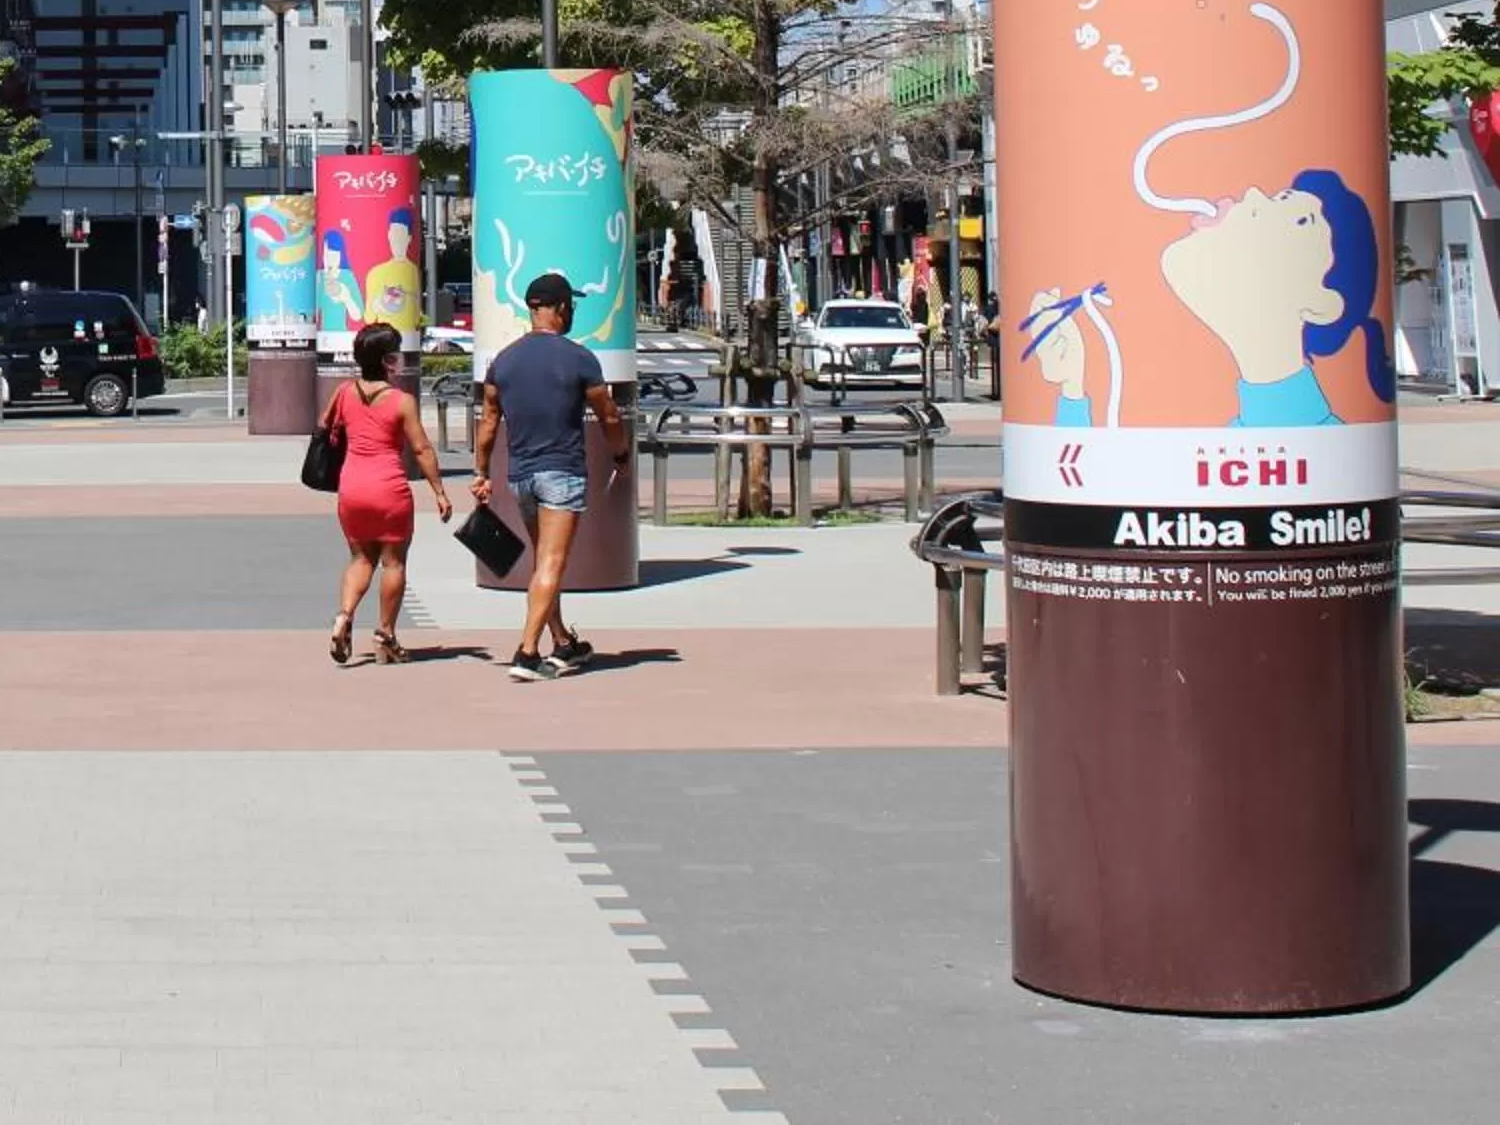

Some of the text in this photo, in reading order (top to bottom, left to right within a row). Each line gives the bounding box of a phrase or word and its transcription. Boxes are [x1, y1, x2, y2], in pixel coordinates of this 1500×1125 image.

[1196, 458, 1309, 487] ICHI
[1113, 506, 1372, 547] Akiba Smile!
[1215, 567, 1240, 584] No
[1245, 565, 1313, 586] smoking
[1315, 567, 1334, 581] on
[1337, 561, 1357, 579] the
[1217, 590, 1243, 602] You
[1271, 588, 1287, 601] be
[1289, 586, 1318, 599] fined
